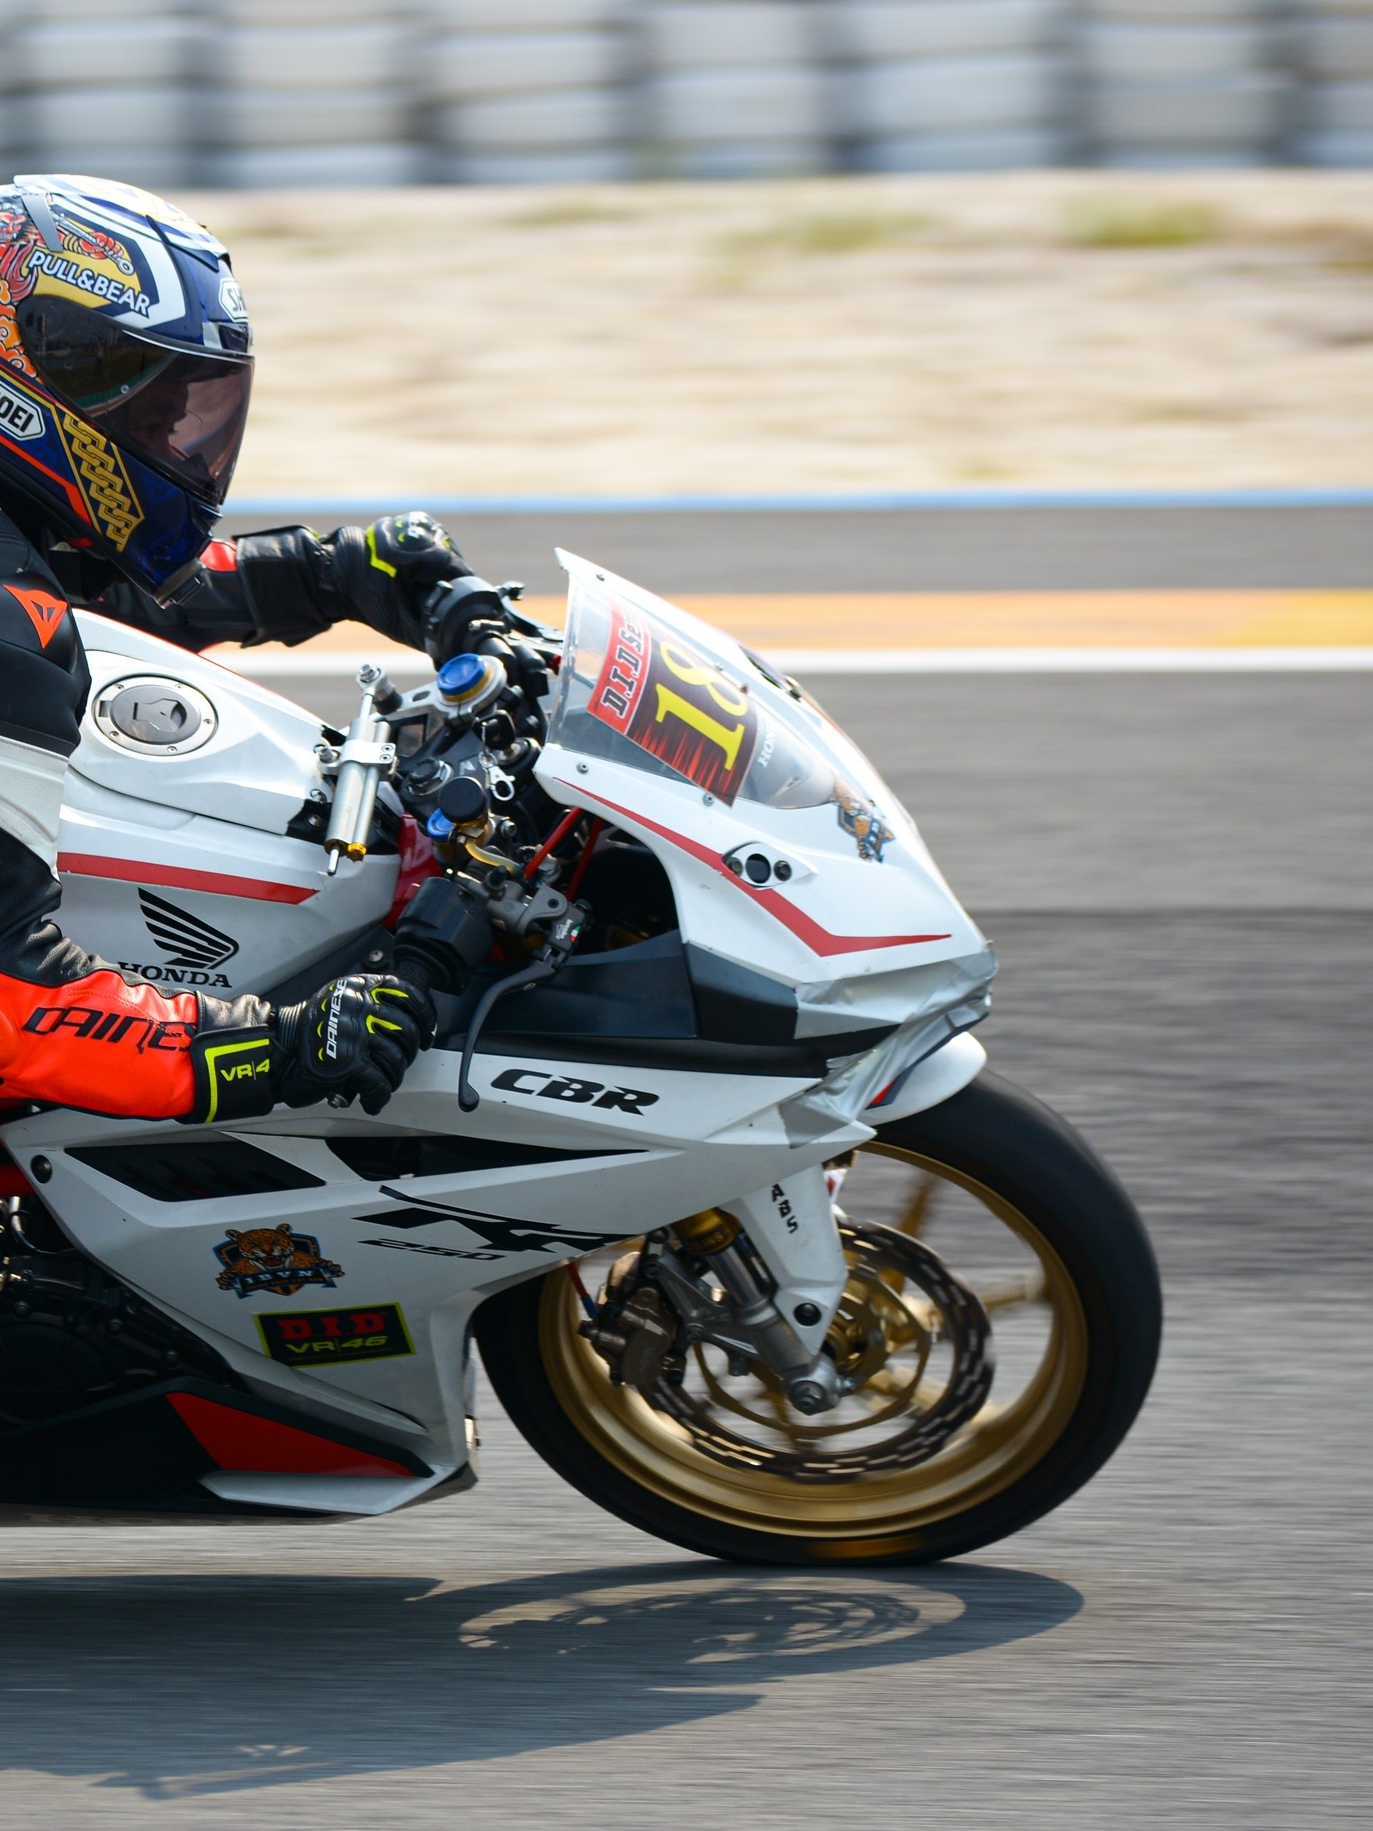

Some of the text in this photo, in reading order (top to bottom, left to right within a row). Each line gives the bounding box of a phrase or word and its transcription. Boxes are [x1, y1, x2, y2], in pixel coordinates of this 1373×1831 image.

[29, 250, 153, 318] PULL&BEAR
[655, 640, 748, 771] 18
[326, 979, 347, 1059] DAINESE
[490, 1069, 660, 1116] CBR
[771, 1183, 798, 1234] ABS
[357, 1238, 507, 1261] 250
